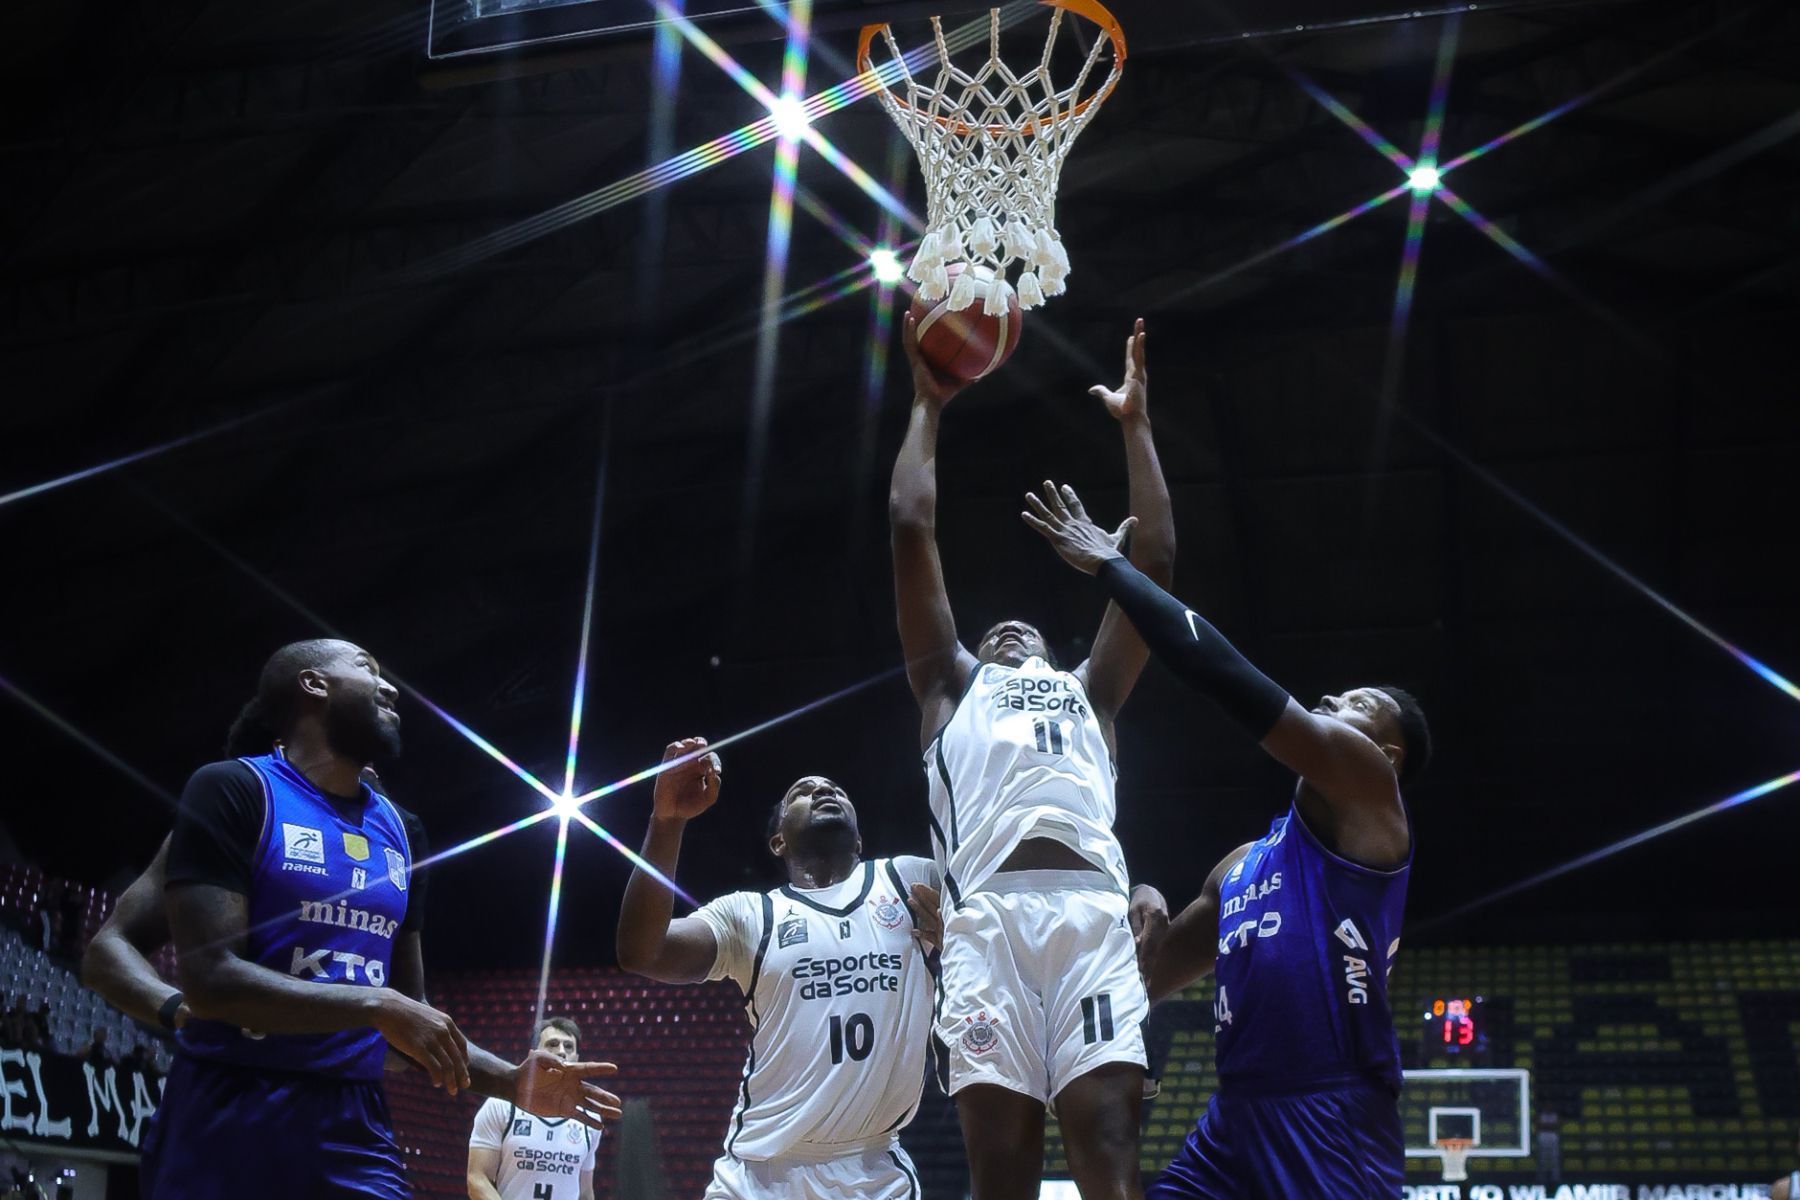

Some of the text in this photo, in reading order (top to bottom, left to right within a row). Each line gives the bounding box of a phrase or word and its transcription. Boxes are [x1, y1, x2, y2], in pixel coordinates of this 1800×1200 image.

[1032, 717, 1063, 755] 11
[299, 900, 398, 939] minas
[290, 946, 385, 988] KTO
[791, 951, 902, 980] Esportes
[1342, 955, 1368, 1005] AVG
[829, 1012, 875, 1066] 10
[1080, 994, 1114, 1045] 11
[83, 1061, 167, 1148] MA
[513, 1146, 580, 1163] Esportes
[533, 1182, 553, 1200] 4
[1637, 1183, 1773, 1200] MARQUE
